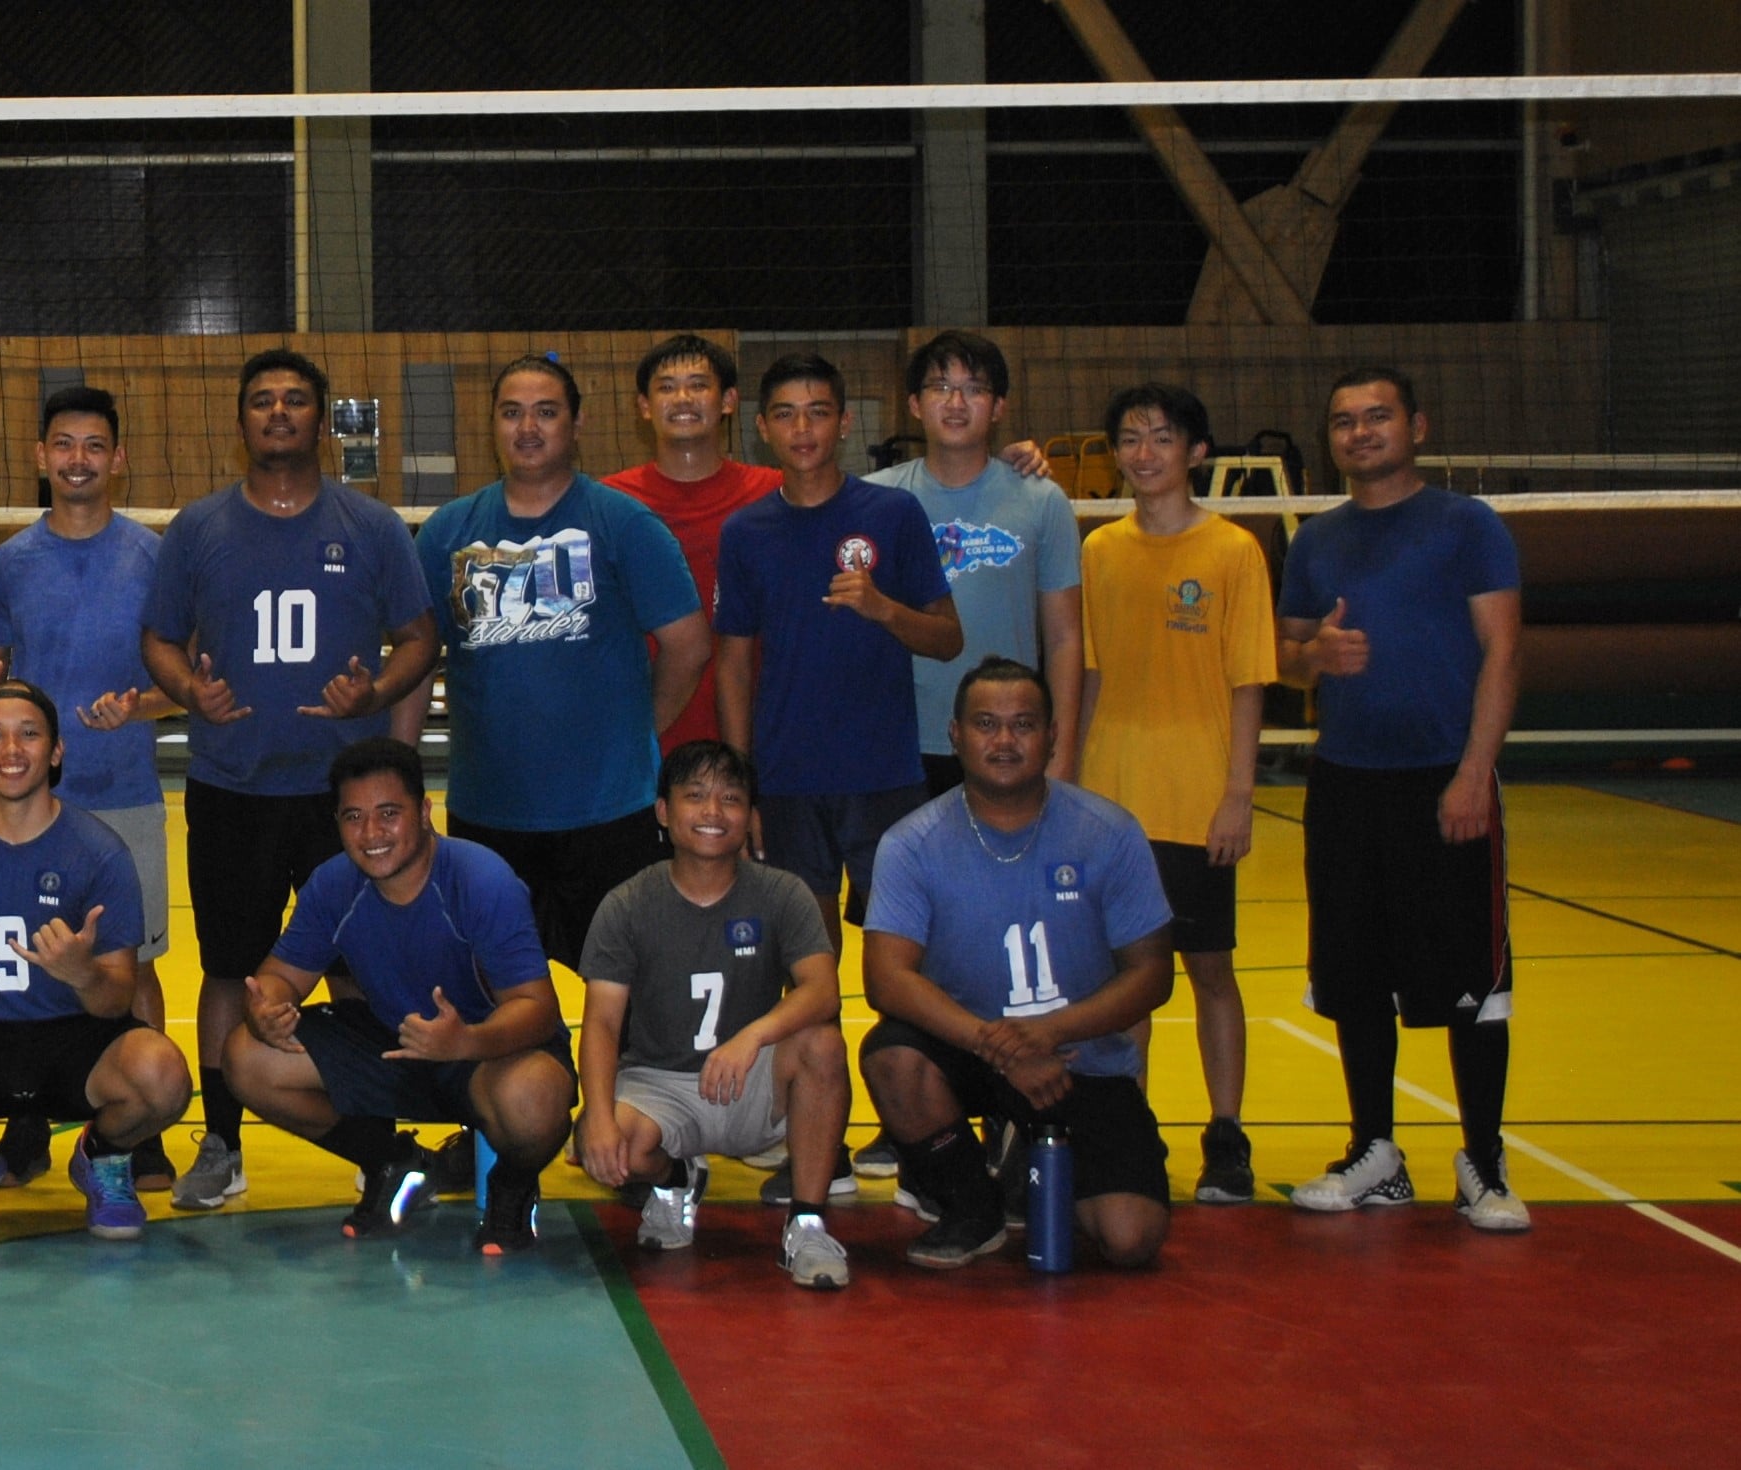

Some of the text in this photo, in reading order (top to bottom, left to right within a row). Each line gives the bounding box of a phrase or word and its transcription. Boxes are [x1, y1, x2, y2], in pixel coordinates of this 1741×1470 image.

[323, 563, 345, 574] NMI
[253, 588, 317, 664] 10
[38, 894, 60, 906] NMI
[1055, 890, 1079, 901] NMI
[734, 945, 756, 957] NMI
[1003, 920, 1060, 1005] 11
[690, 971, 724, 1051] 7
